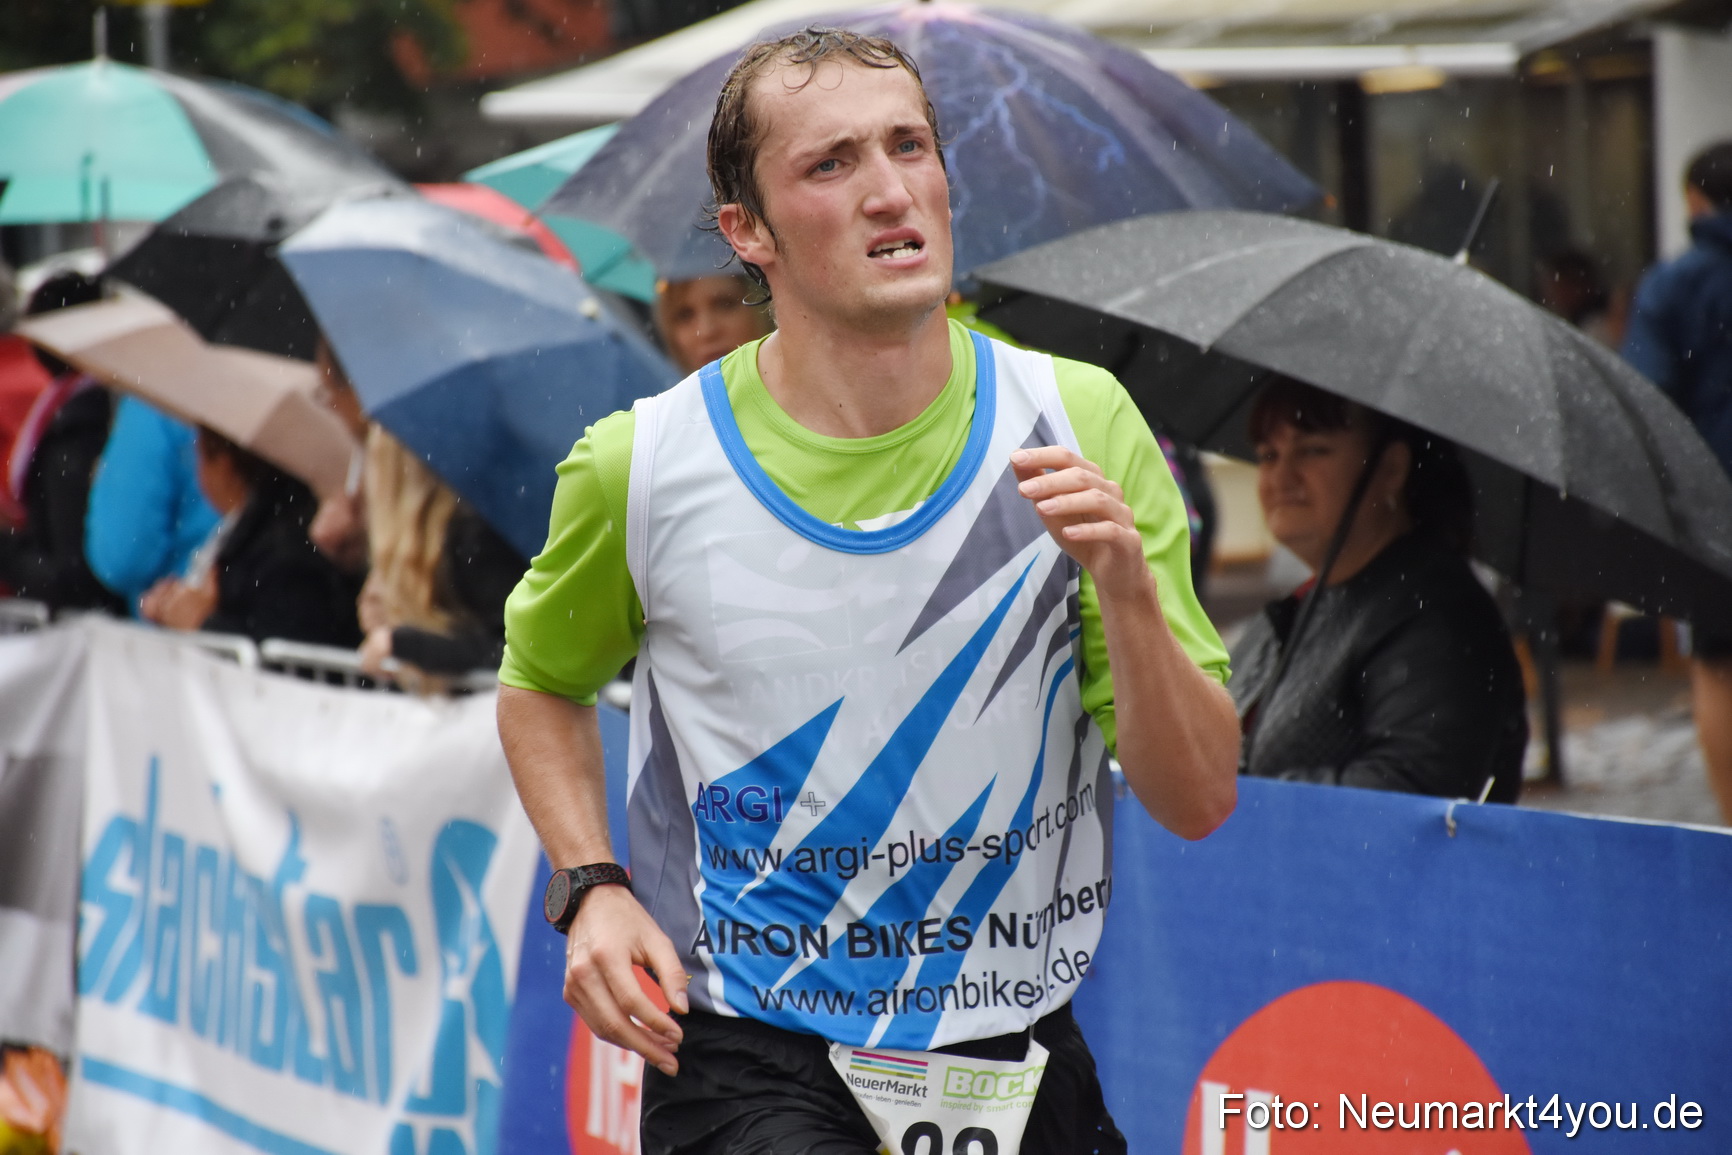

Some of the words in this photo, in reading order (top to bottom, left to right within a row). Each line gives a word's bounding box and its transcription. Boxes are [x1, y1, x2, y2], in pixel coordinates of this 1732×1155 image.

[694, 781, 783, 823] ARGI
[706, 782, 1096, 880] www.argi-plus-sport.com
[690, 919, 828, 960] AIRON
[846, 916, 973, 959] BIKES
[845, 1072, 928, 1098] NeuerMarkt
[940, 1099, 972, 1111] inspired
[973, 1101, 984, 1113] by
[986, 1100, 1014, 1113] smart
